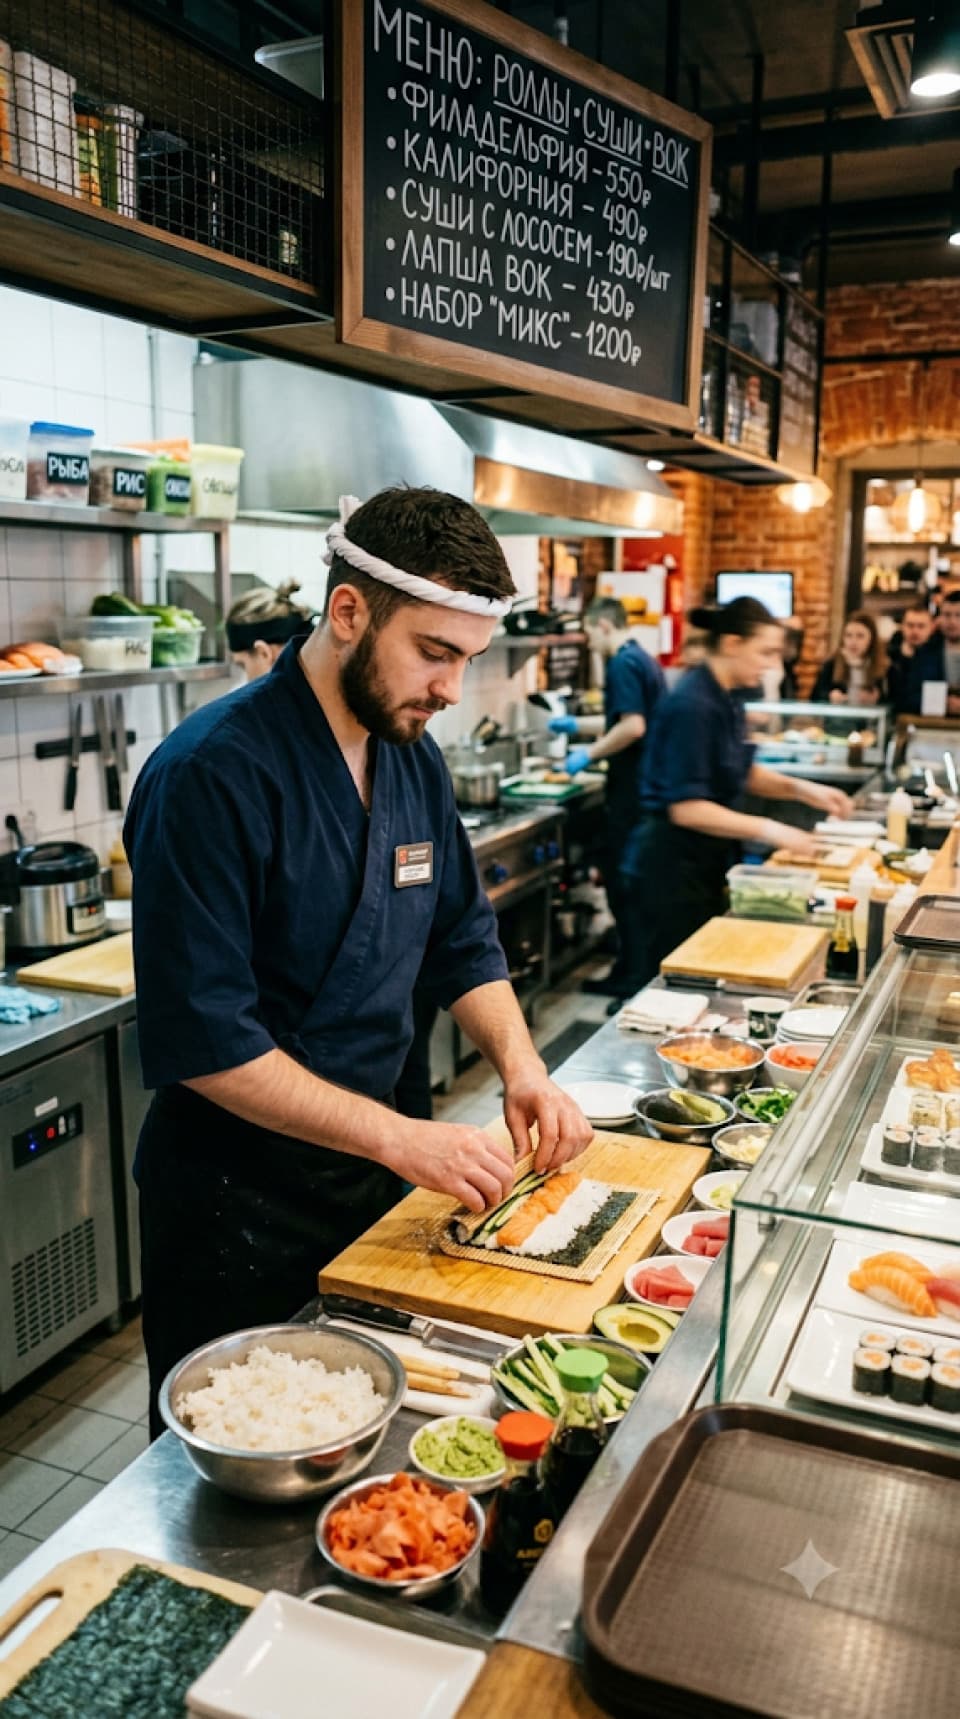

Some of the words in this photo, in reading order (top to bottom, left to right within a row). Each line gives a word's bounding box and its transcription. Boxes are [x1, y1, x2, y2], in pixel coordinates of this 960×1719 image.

[374, 0, 483, 90] МЕНЮ:
[493, 54, 570, 128] РОЛЛЫ
[583, 98, 642, 161] СУШИ
[652, 131, 690, 183] ВОК
[402, 81, 588, 183] ФИЛАДЕЛЬФИЯ
[404, 128, 573, 220] КАЛИФОРНИЯ
[402, 178, 474, 235] СУШИ
[482, 202, 496, 240] С
[501, 208, 593, 268] ЛОСОСЕМ
[401, 229, 494, 287] ЛАПША
[505, 254, 552, 302] ВОК
[401, 277, 484, 330] НАБОР
[48, 455, 88, 480] РЫБА
[116, 471, 146, 495] РИС
